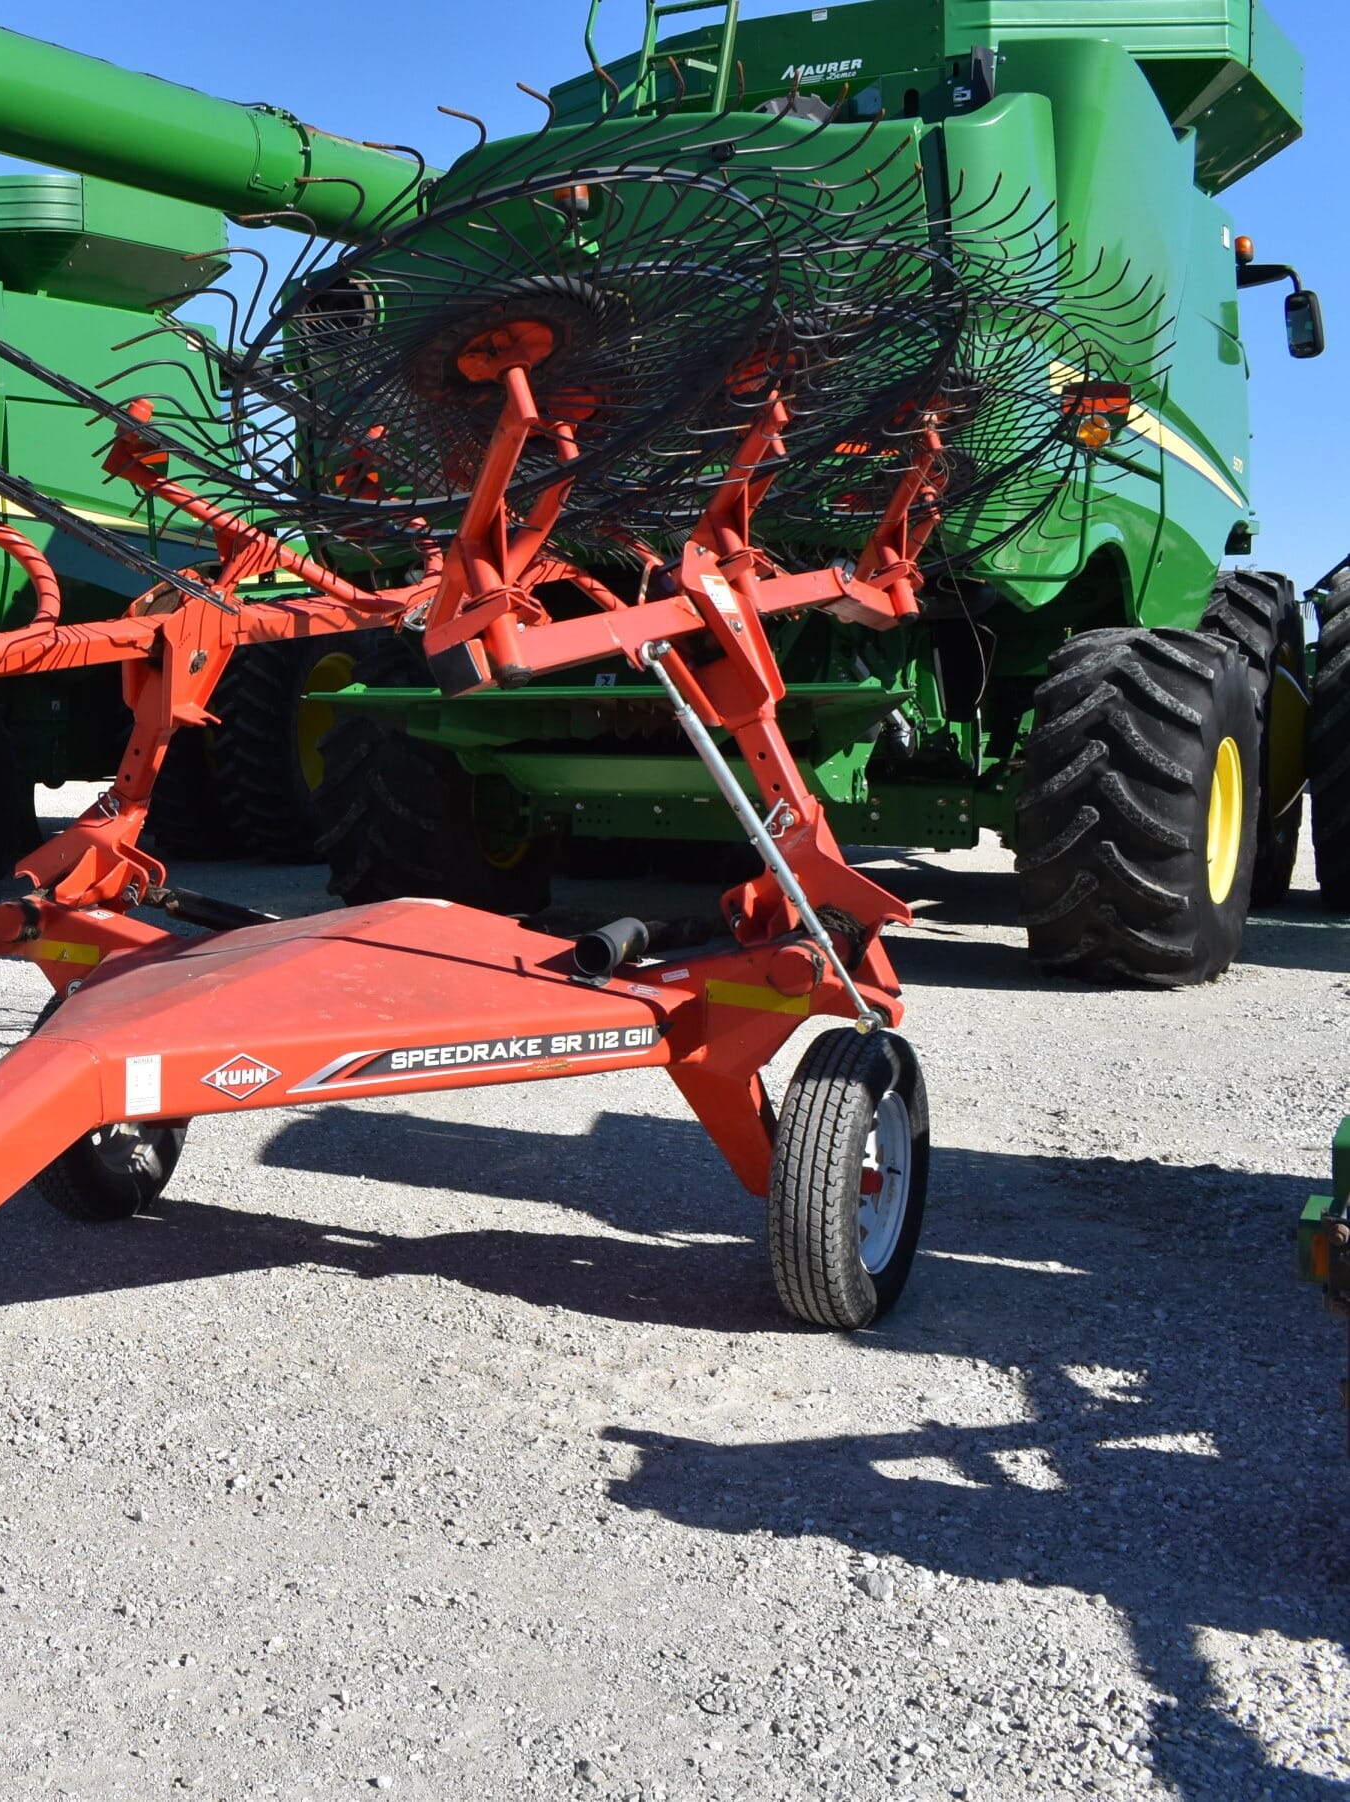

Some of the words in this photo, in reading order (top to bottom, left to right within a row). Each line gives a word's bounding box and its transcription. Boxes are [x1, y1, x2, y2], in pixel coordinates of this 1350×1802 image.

[780, 58, 863, 84] MAURER
[390, 1037, 542, 1070] SPEEDRAKE
[550, 1034, 583, 1054] SR
[588, 1031, 620, 1050] 112
[215, 1067, 268, 1088] KUHN
